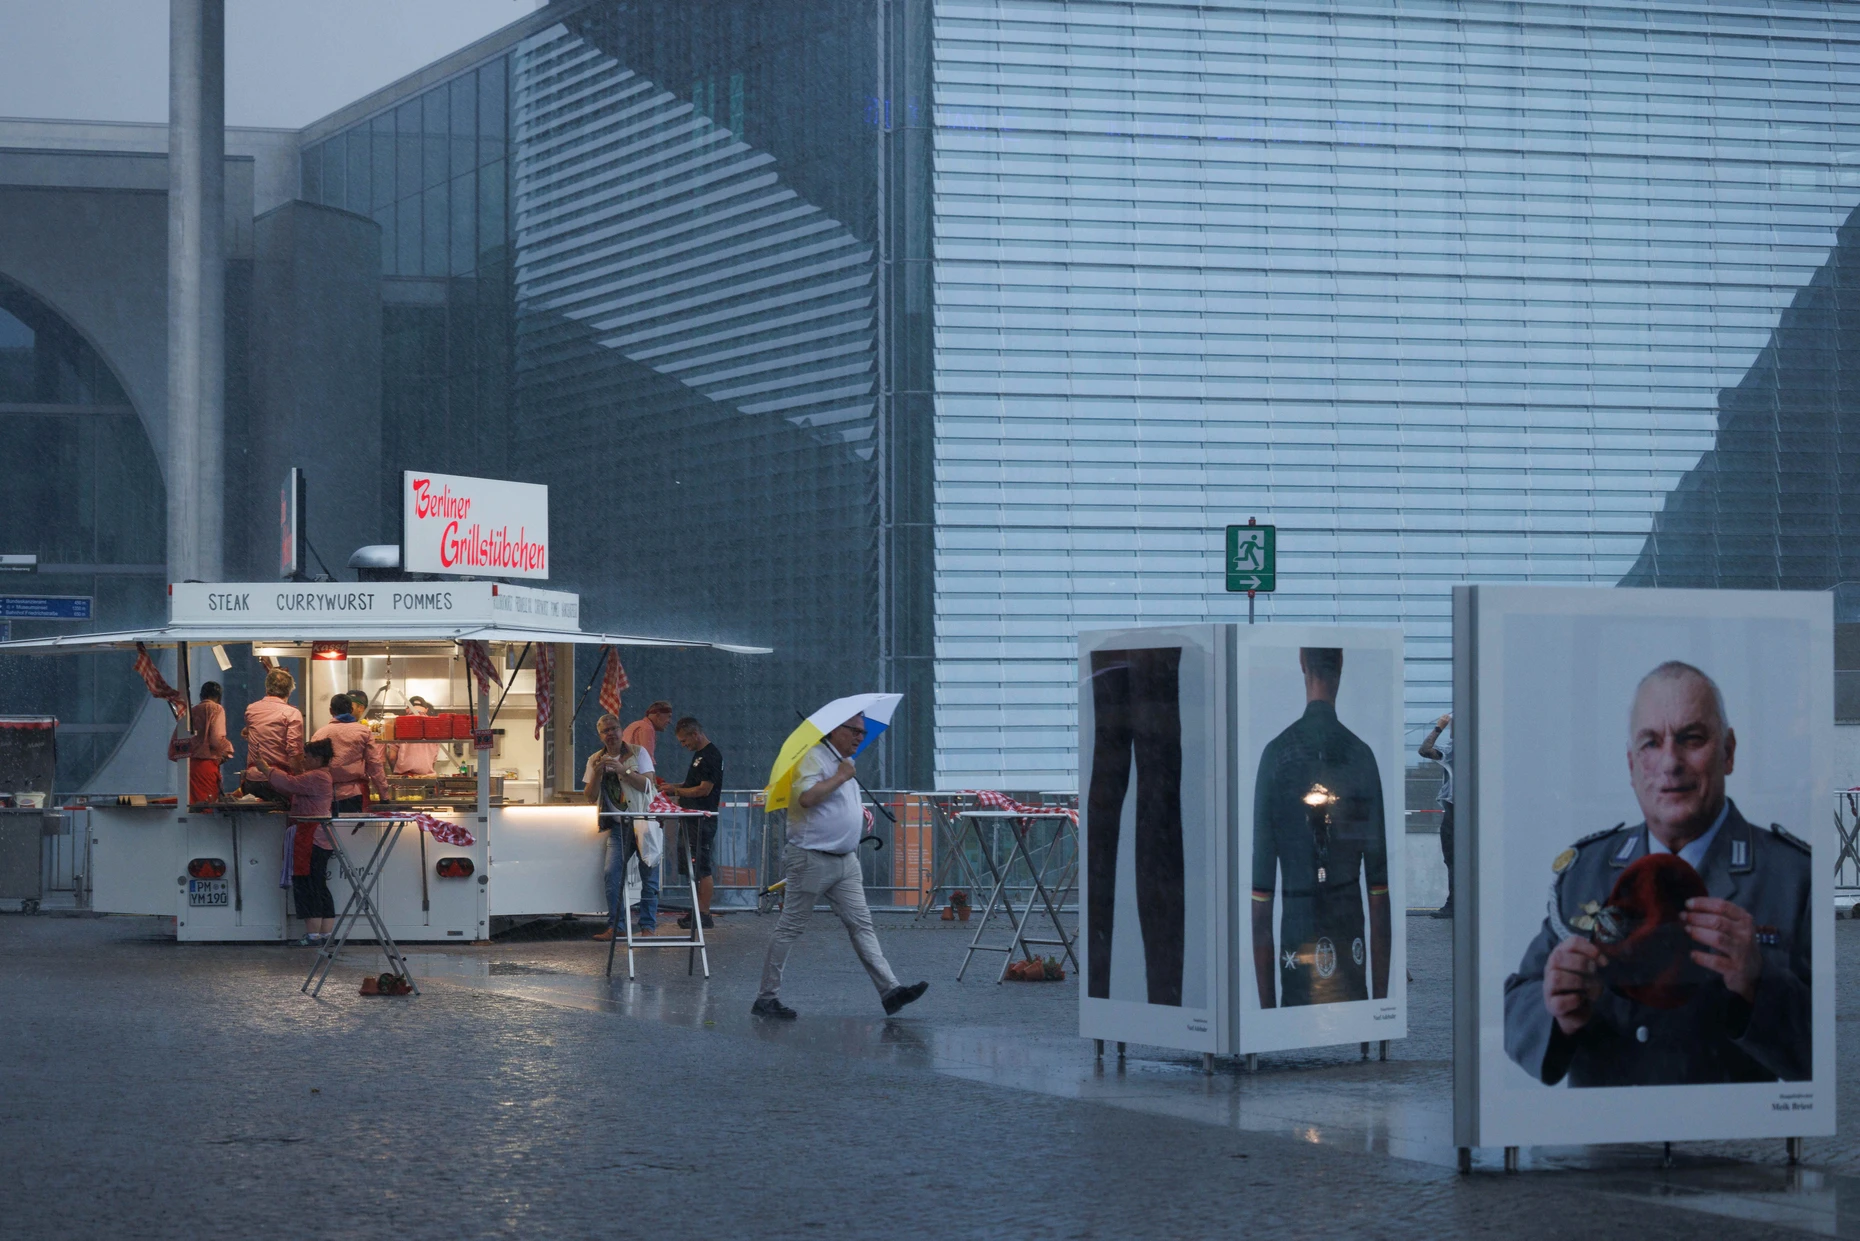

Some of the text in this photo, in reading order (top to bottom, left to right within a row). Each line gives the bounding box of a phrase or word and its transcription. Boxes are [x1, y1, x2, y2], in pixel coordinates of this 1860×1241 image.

[413, 478, 471, 520] Berliner
[440, 520, 545, 572] Grillstübchen
[208, 592, 453, 611] STEAK CURRYWURST POMMES
[197, 881, 211, 892] PM
